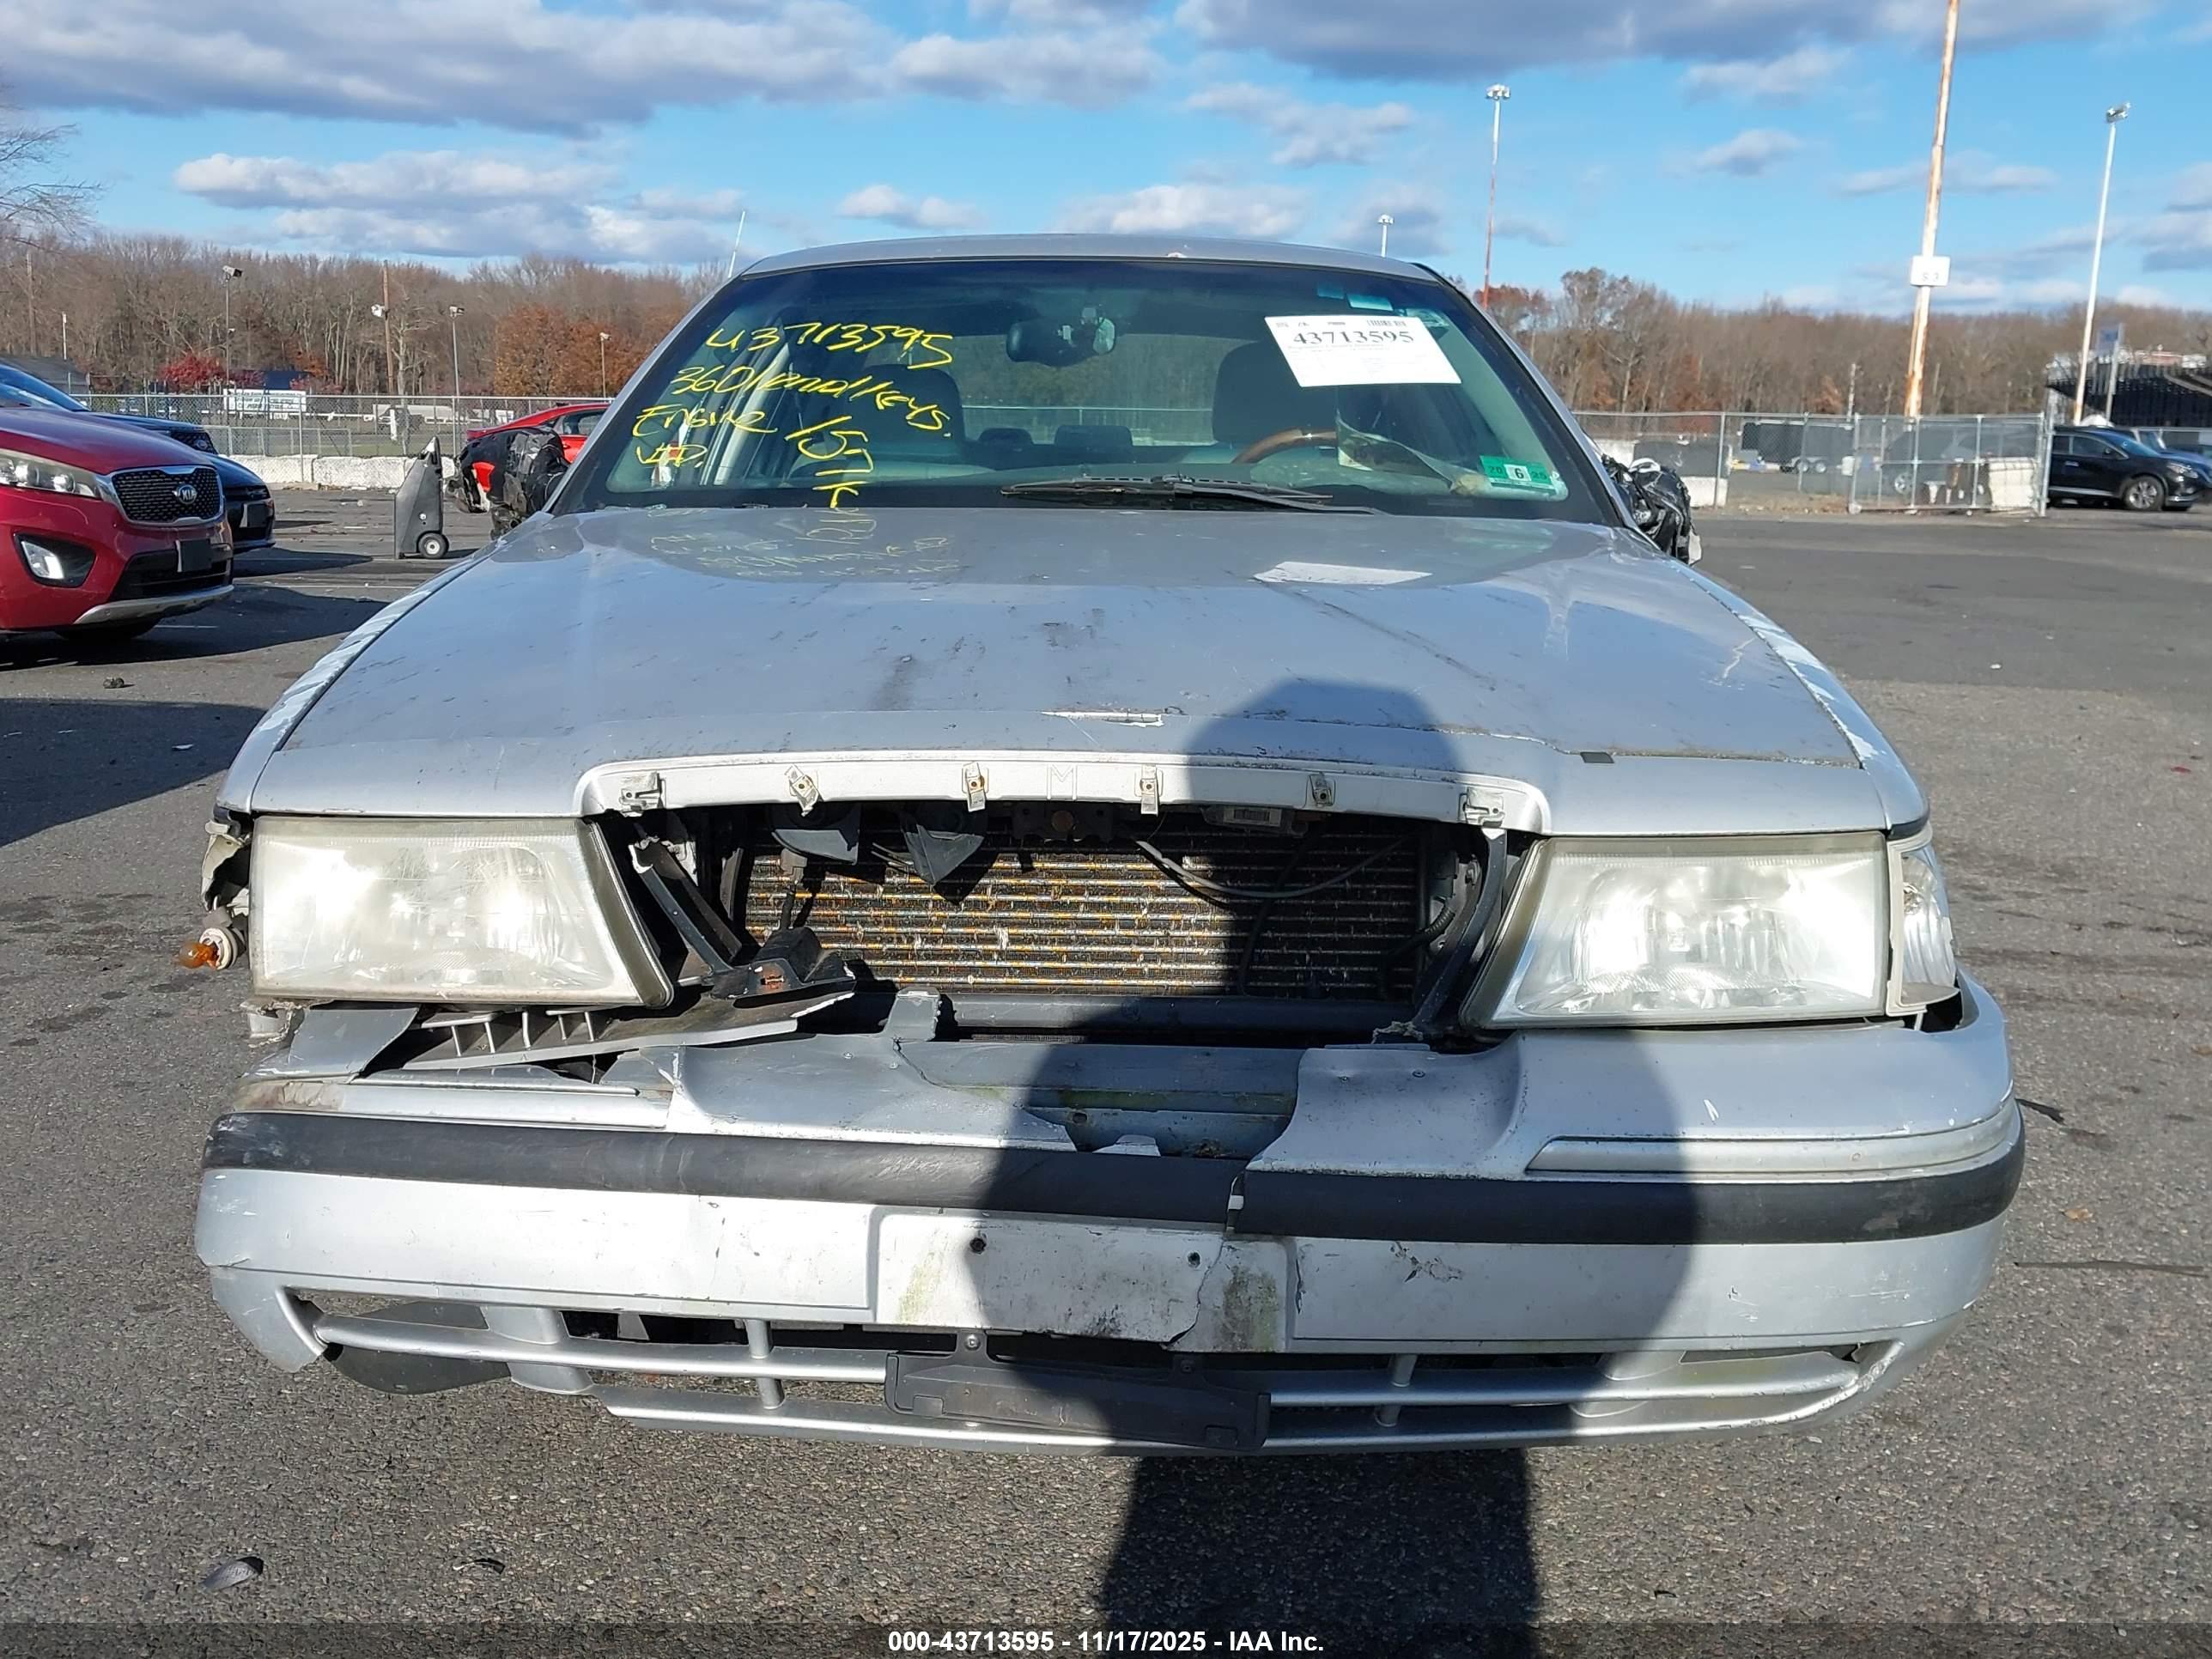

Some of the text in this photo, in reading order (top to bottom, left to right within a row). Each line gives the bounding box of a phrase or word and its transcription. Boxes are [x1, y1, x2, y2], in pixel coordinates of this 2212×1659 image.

[1292, 330, 1415, 345] 43713595
[1514, 467, 1524, 479] 6
[181, 489, 198, 501] KIA
